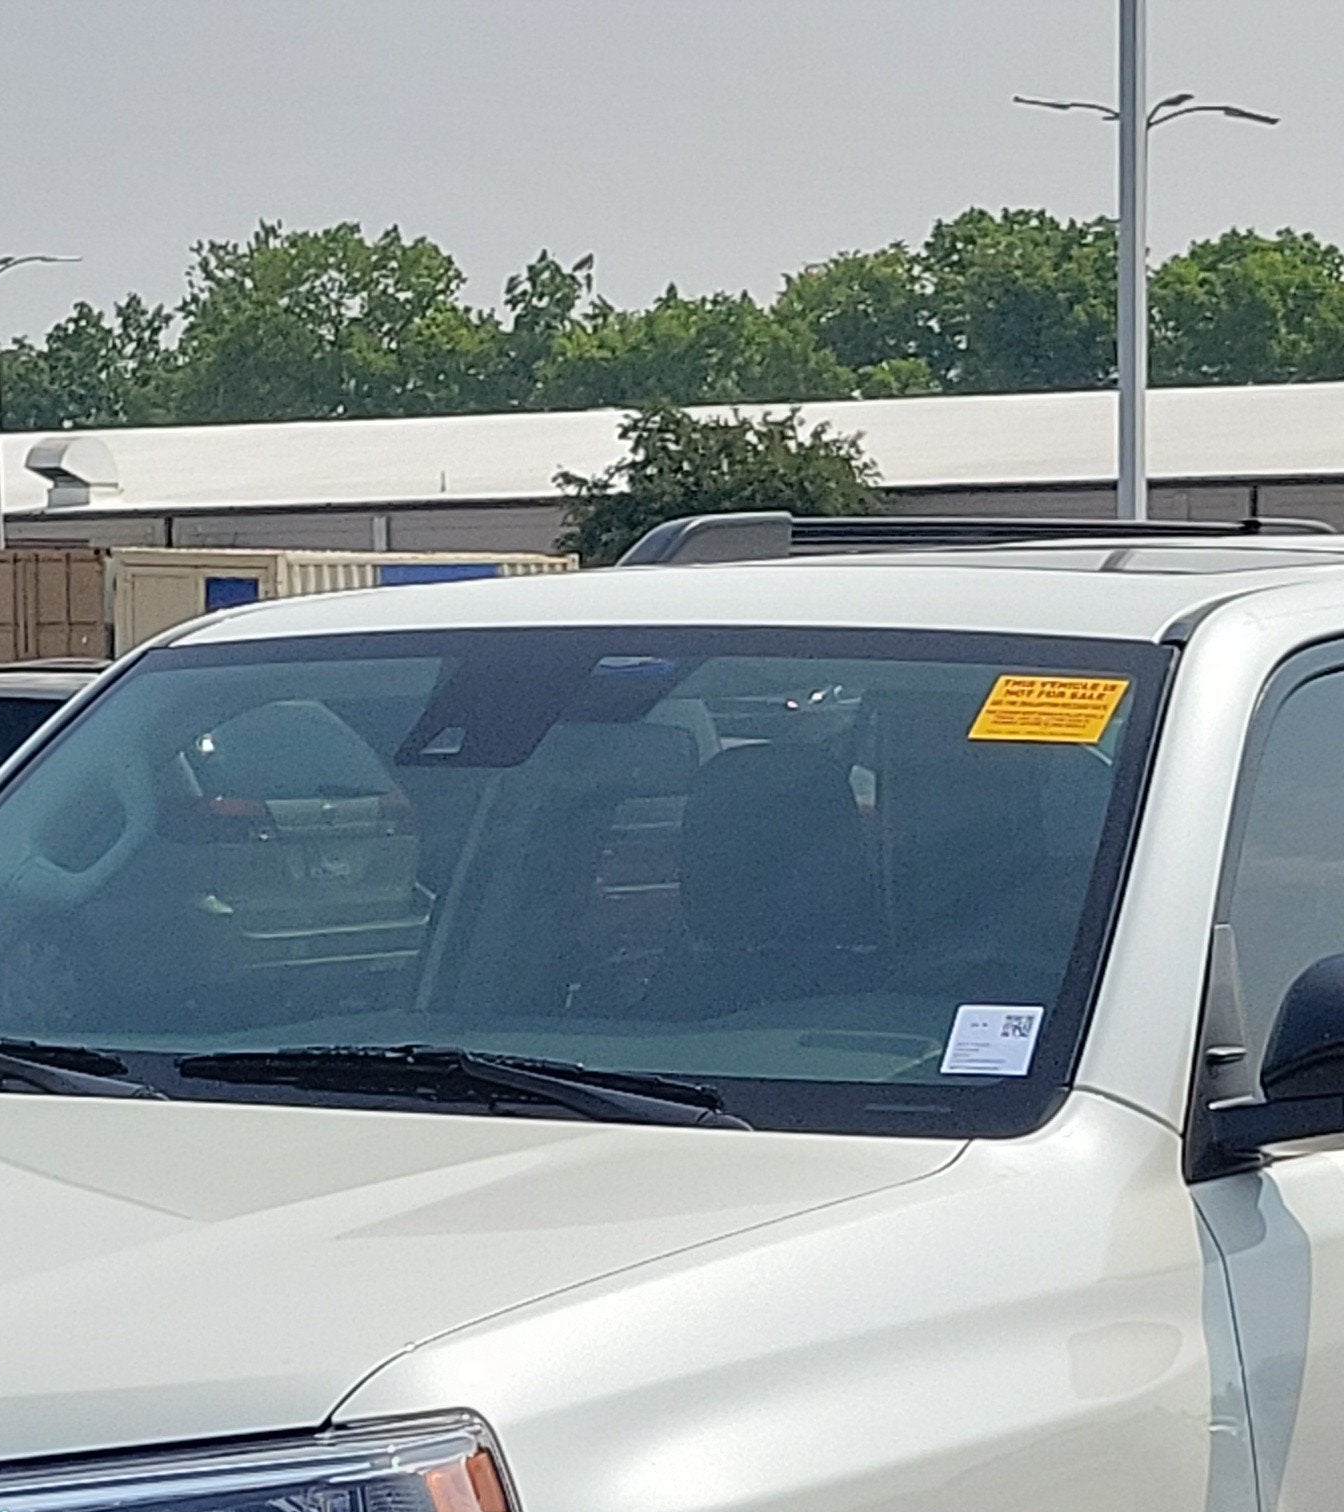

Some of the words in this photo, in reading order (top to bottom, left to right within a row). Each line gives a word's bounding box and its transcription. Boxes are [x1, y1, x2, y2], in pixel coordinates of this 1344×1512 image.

[1004, 678, 1035, 688] THIS
[1040, 680, 1099, 691] VEHICLE
[1102, 684, 1118, 692] IS
[1005, 688, 1034, 698] NOT
[1037, 690, 1066, 699] FOR
[1070, 692, 1106, 701] SALE
